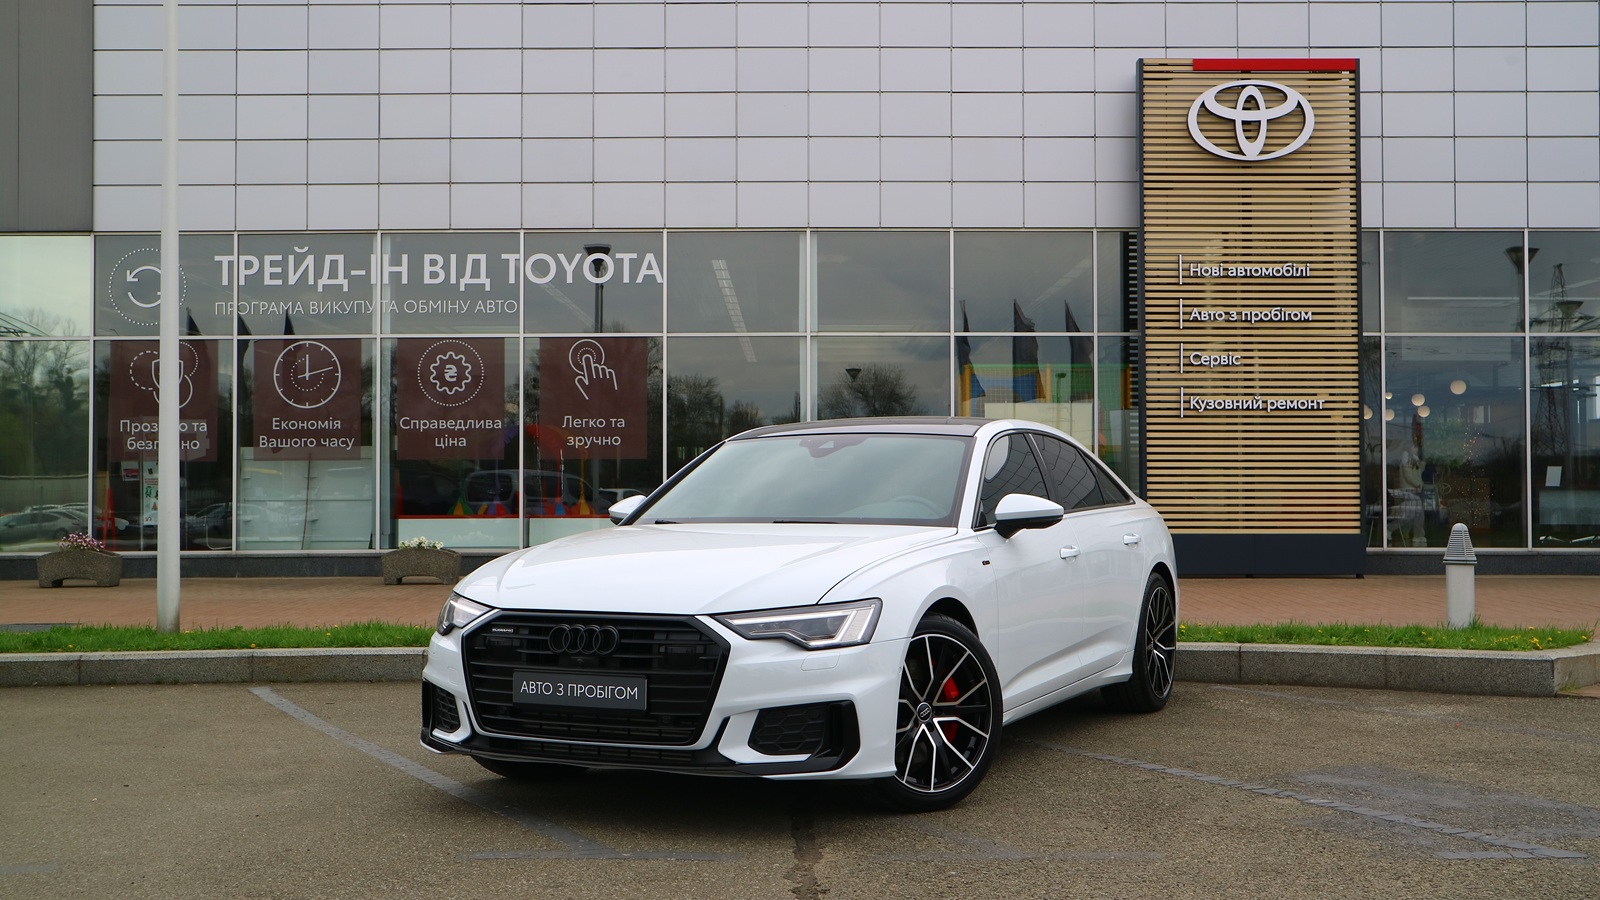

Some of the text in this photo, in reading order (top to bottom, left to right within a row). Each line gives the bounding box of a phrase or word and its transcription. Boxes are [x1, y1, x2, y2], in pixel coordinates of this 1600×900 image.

[214, 246, 663, 292] ТРЕЙД-ІН ВІД TOYOTA
[1189, 262, 1311, 277] Нові автомобілі
[215, 300, 518, 315] ПРОГРАМА ВИКУПУ ТА ОБМІНУ АВТО
[1189, 307, 1313, 324] Авто з пробігом
[1189, 352, 1242, 369] Сервіс
[1189, 395, 1325, 413] Кузовний ремонт
[119, 419, 208, 436] Прозо та
[272, 417, 342, 430] Економія
[399, 416, 502, 430] Справедлива
[561, 415, 626, 428] Легко та
[259, 435, 355, 451] Вашого часу
[434, 434, 467, 448] ціна
[566, 435, 622, 449] зручно
[520, 681, 553, 695] АВТО
[567, 683, 639, 700] ПРОБІГОМ
